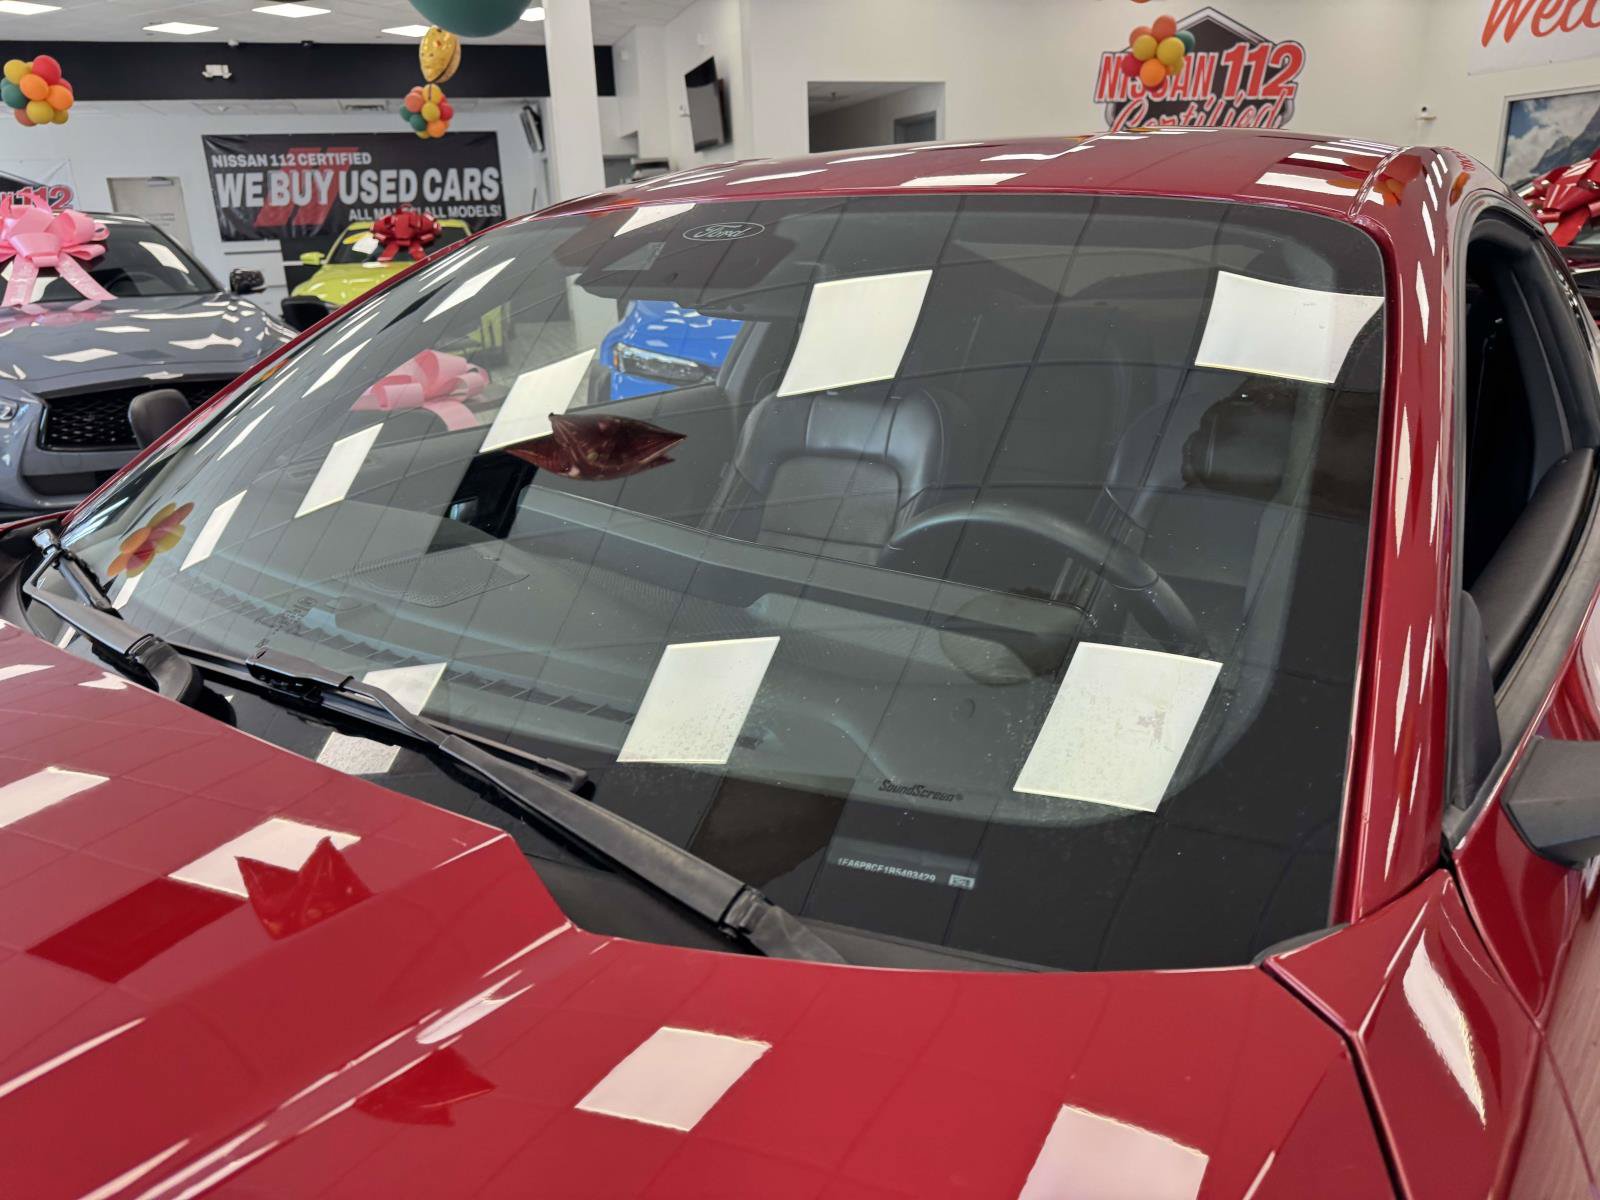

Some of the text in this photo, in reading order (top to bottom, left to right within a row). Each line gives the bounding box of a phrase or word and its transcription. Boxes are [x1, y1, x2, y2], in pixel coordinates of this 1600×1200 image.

[1221, 41, 1305, 99] 112
[211, 151, 372, 168] NISSAN 112 CERTIFIED
[215, 166, 500, 208] WE BUY USED CARS
[348, 207, 373, 221] ALL
[447, 204, 502, 218] MODELS!
[693, 224, 752, 238] Ford
